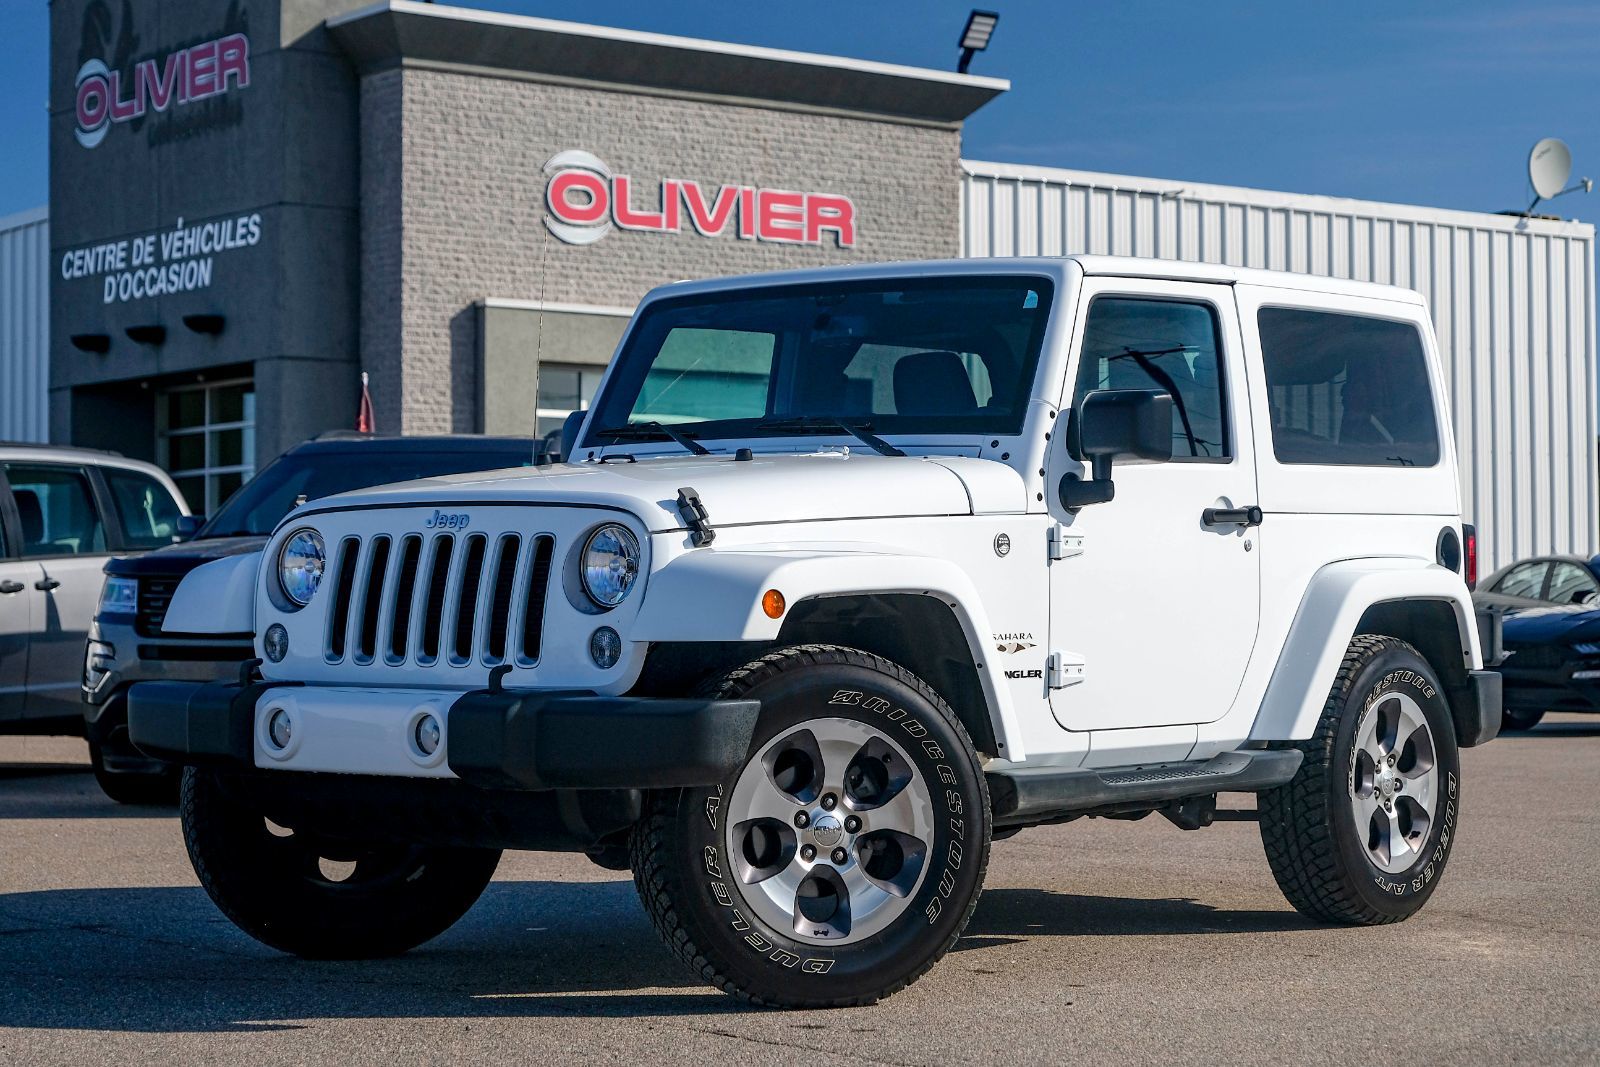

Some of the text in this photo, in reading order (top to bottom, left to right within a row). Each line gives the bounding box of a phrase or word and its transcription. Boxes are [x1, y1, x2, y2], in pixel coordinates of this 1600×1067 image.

[75, 32, 249, 131] OLIVIER
[61, 213, 262, 280] CENTRE DE VÉHICULES
[546, 168, 856, 249] OLIVIER
[103, 258, 213, 304] D'OCCASION
[425, 509, 470, 532] Jeep
[1004, 669, 1042, 679] NGLER
[828, 689, 965, 924] BRIDGESTONE
[1411, 771, 1457, 893] DUELER
[704, 845, 836, 975] DUELER
